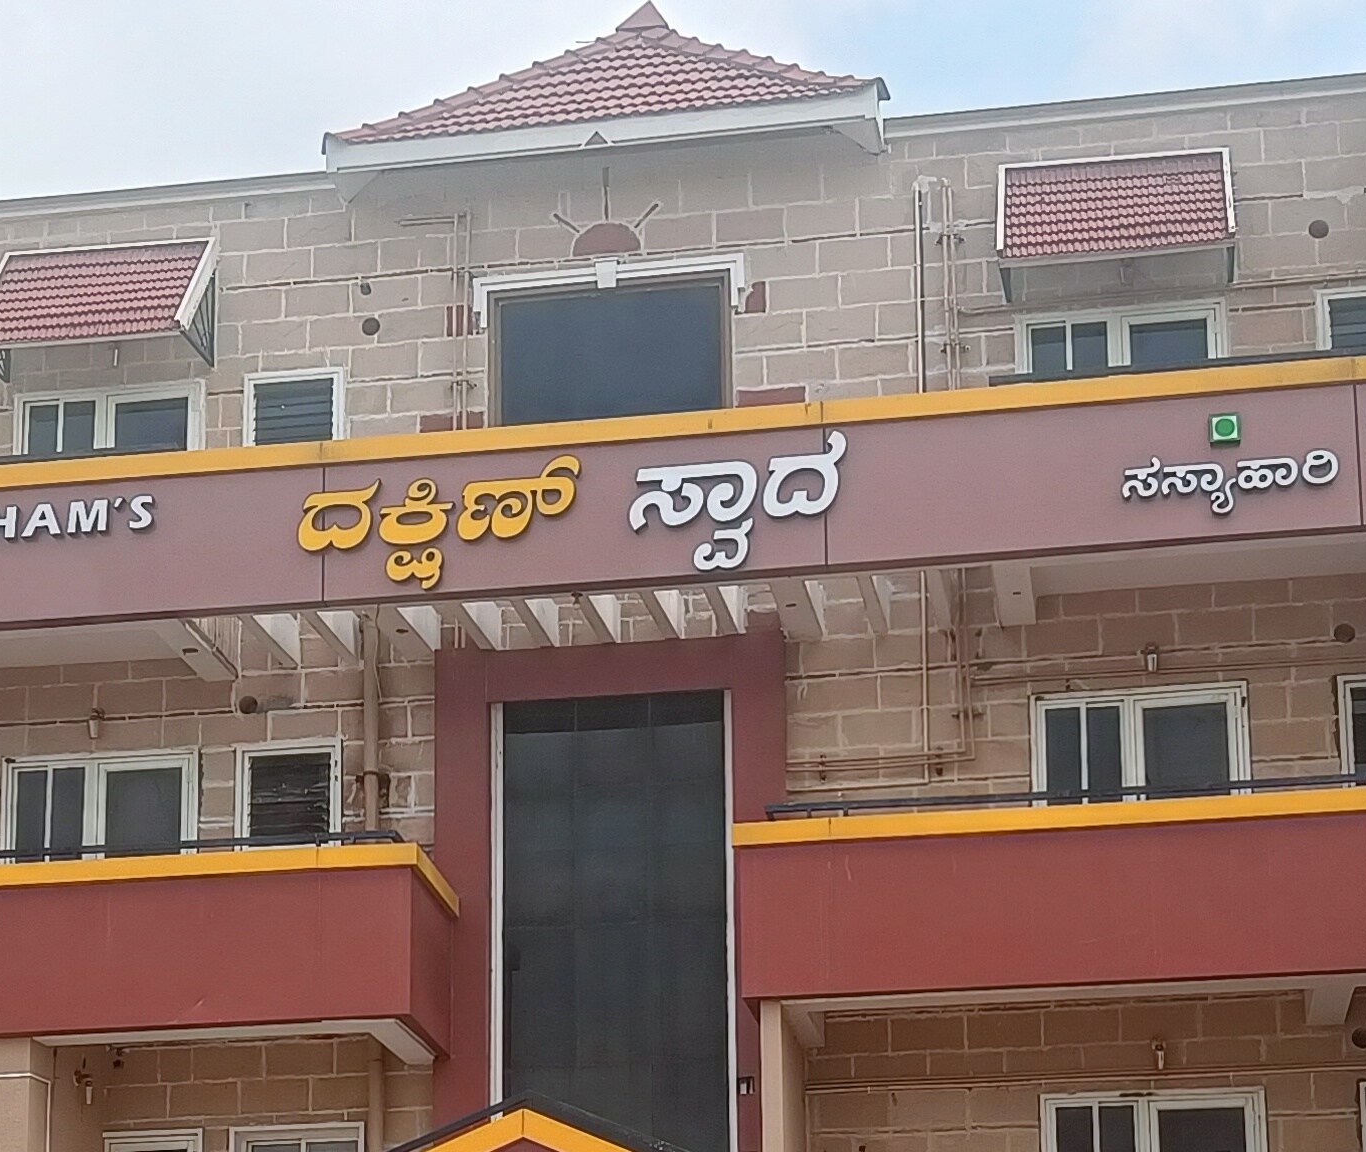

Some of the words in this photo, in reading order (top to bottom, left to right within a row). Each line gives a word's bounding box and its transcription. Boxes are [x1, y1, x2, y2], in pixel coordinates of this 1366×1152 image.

[296, 454, 581, 591] ದಕ್ಷಿಣ್
[629, 430, 847, 571] ಸ್ವಾದ
[1121, 448, 1339, 515] ಸಸ್ಯಾಹಾರಿ
